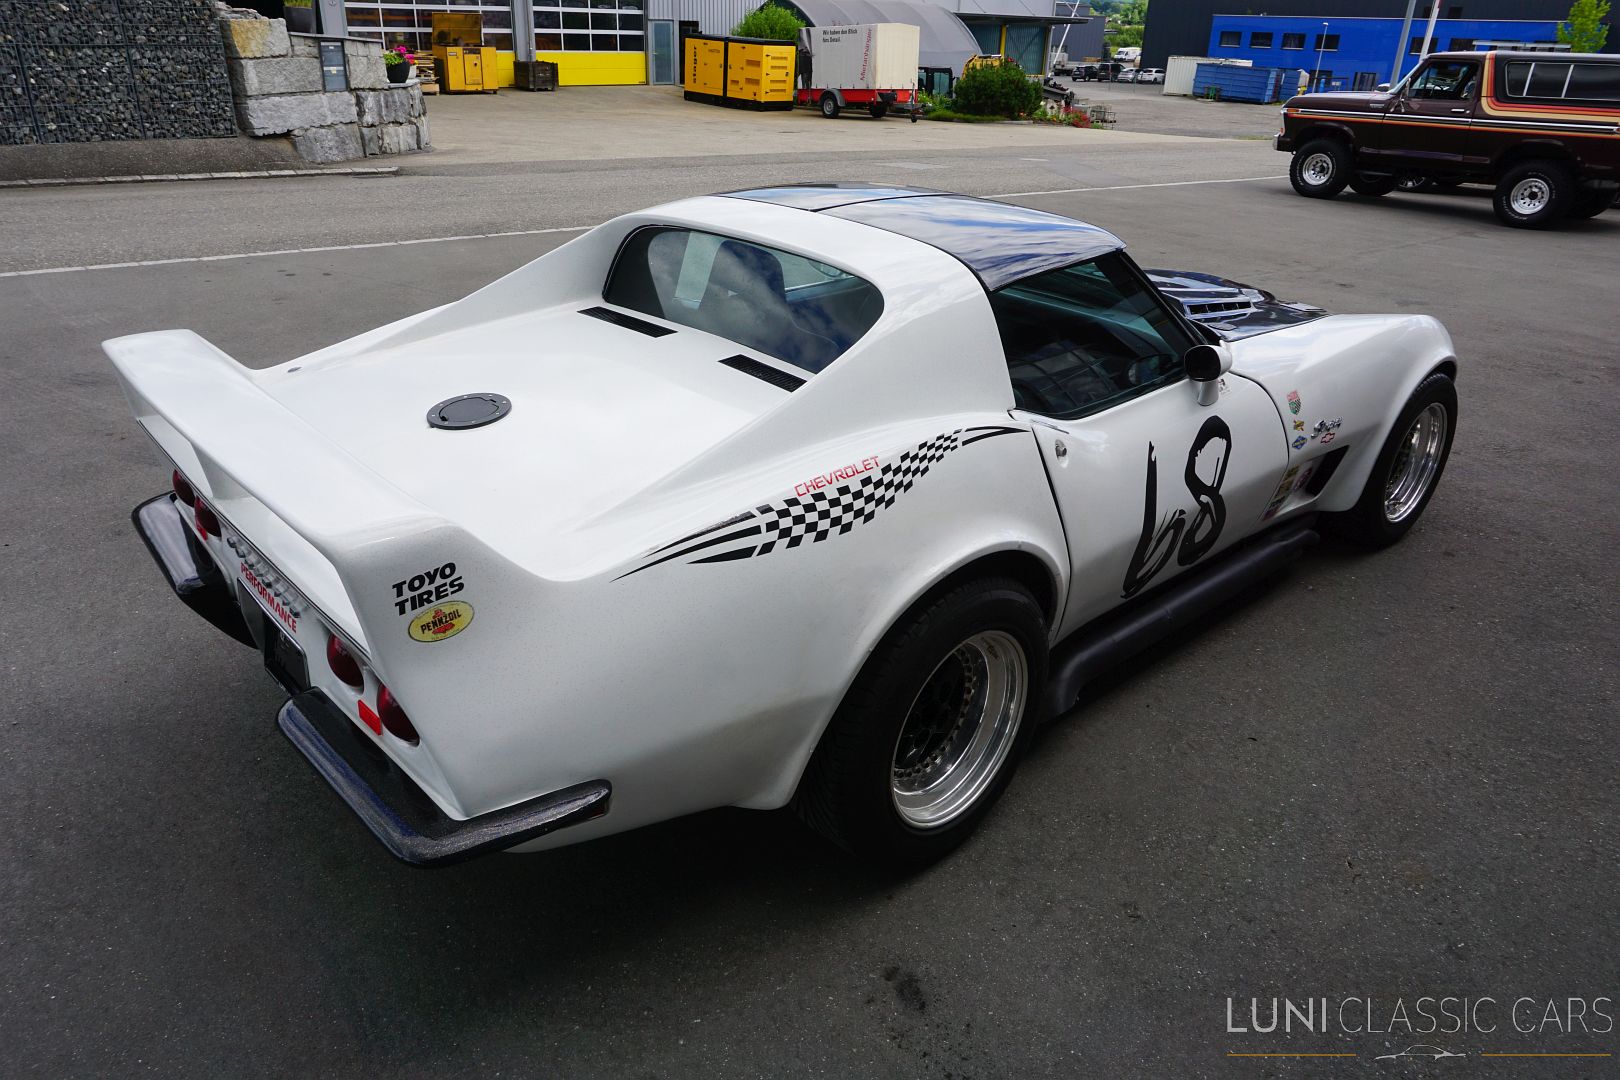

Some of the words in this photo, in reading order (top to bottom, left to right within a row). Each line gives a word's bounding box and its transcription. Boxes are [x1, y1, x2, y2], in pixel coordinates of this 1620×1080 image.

[794, 455, 880, 497] CHEVROLET
[1120, 415, 1232, 599] 68
[240, 561, 297, 634] PERFORMANCE
[392, 562, 456, 598] TOYO
[394, 575, 465, 616] TIRES
[420, 609, 462, 634] PENNZOIL
